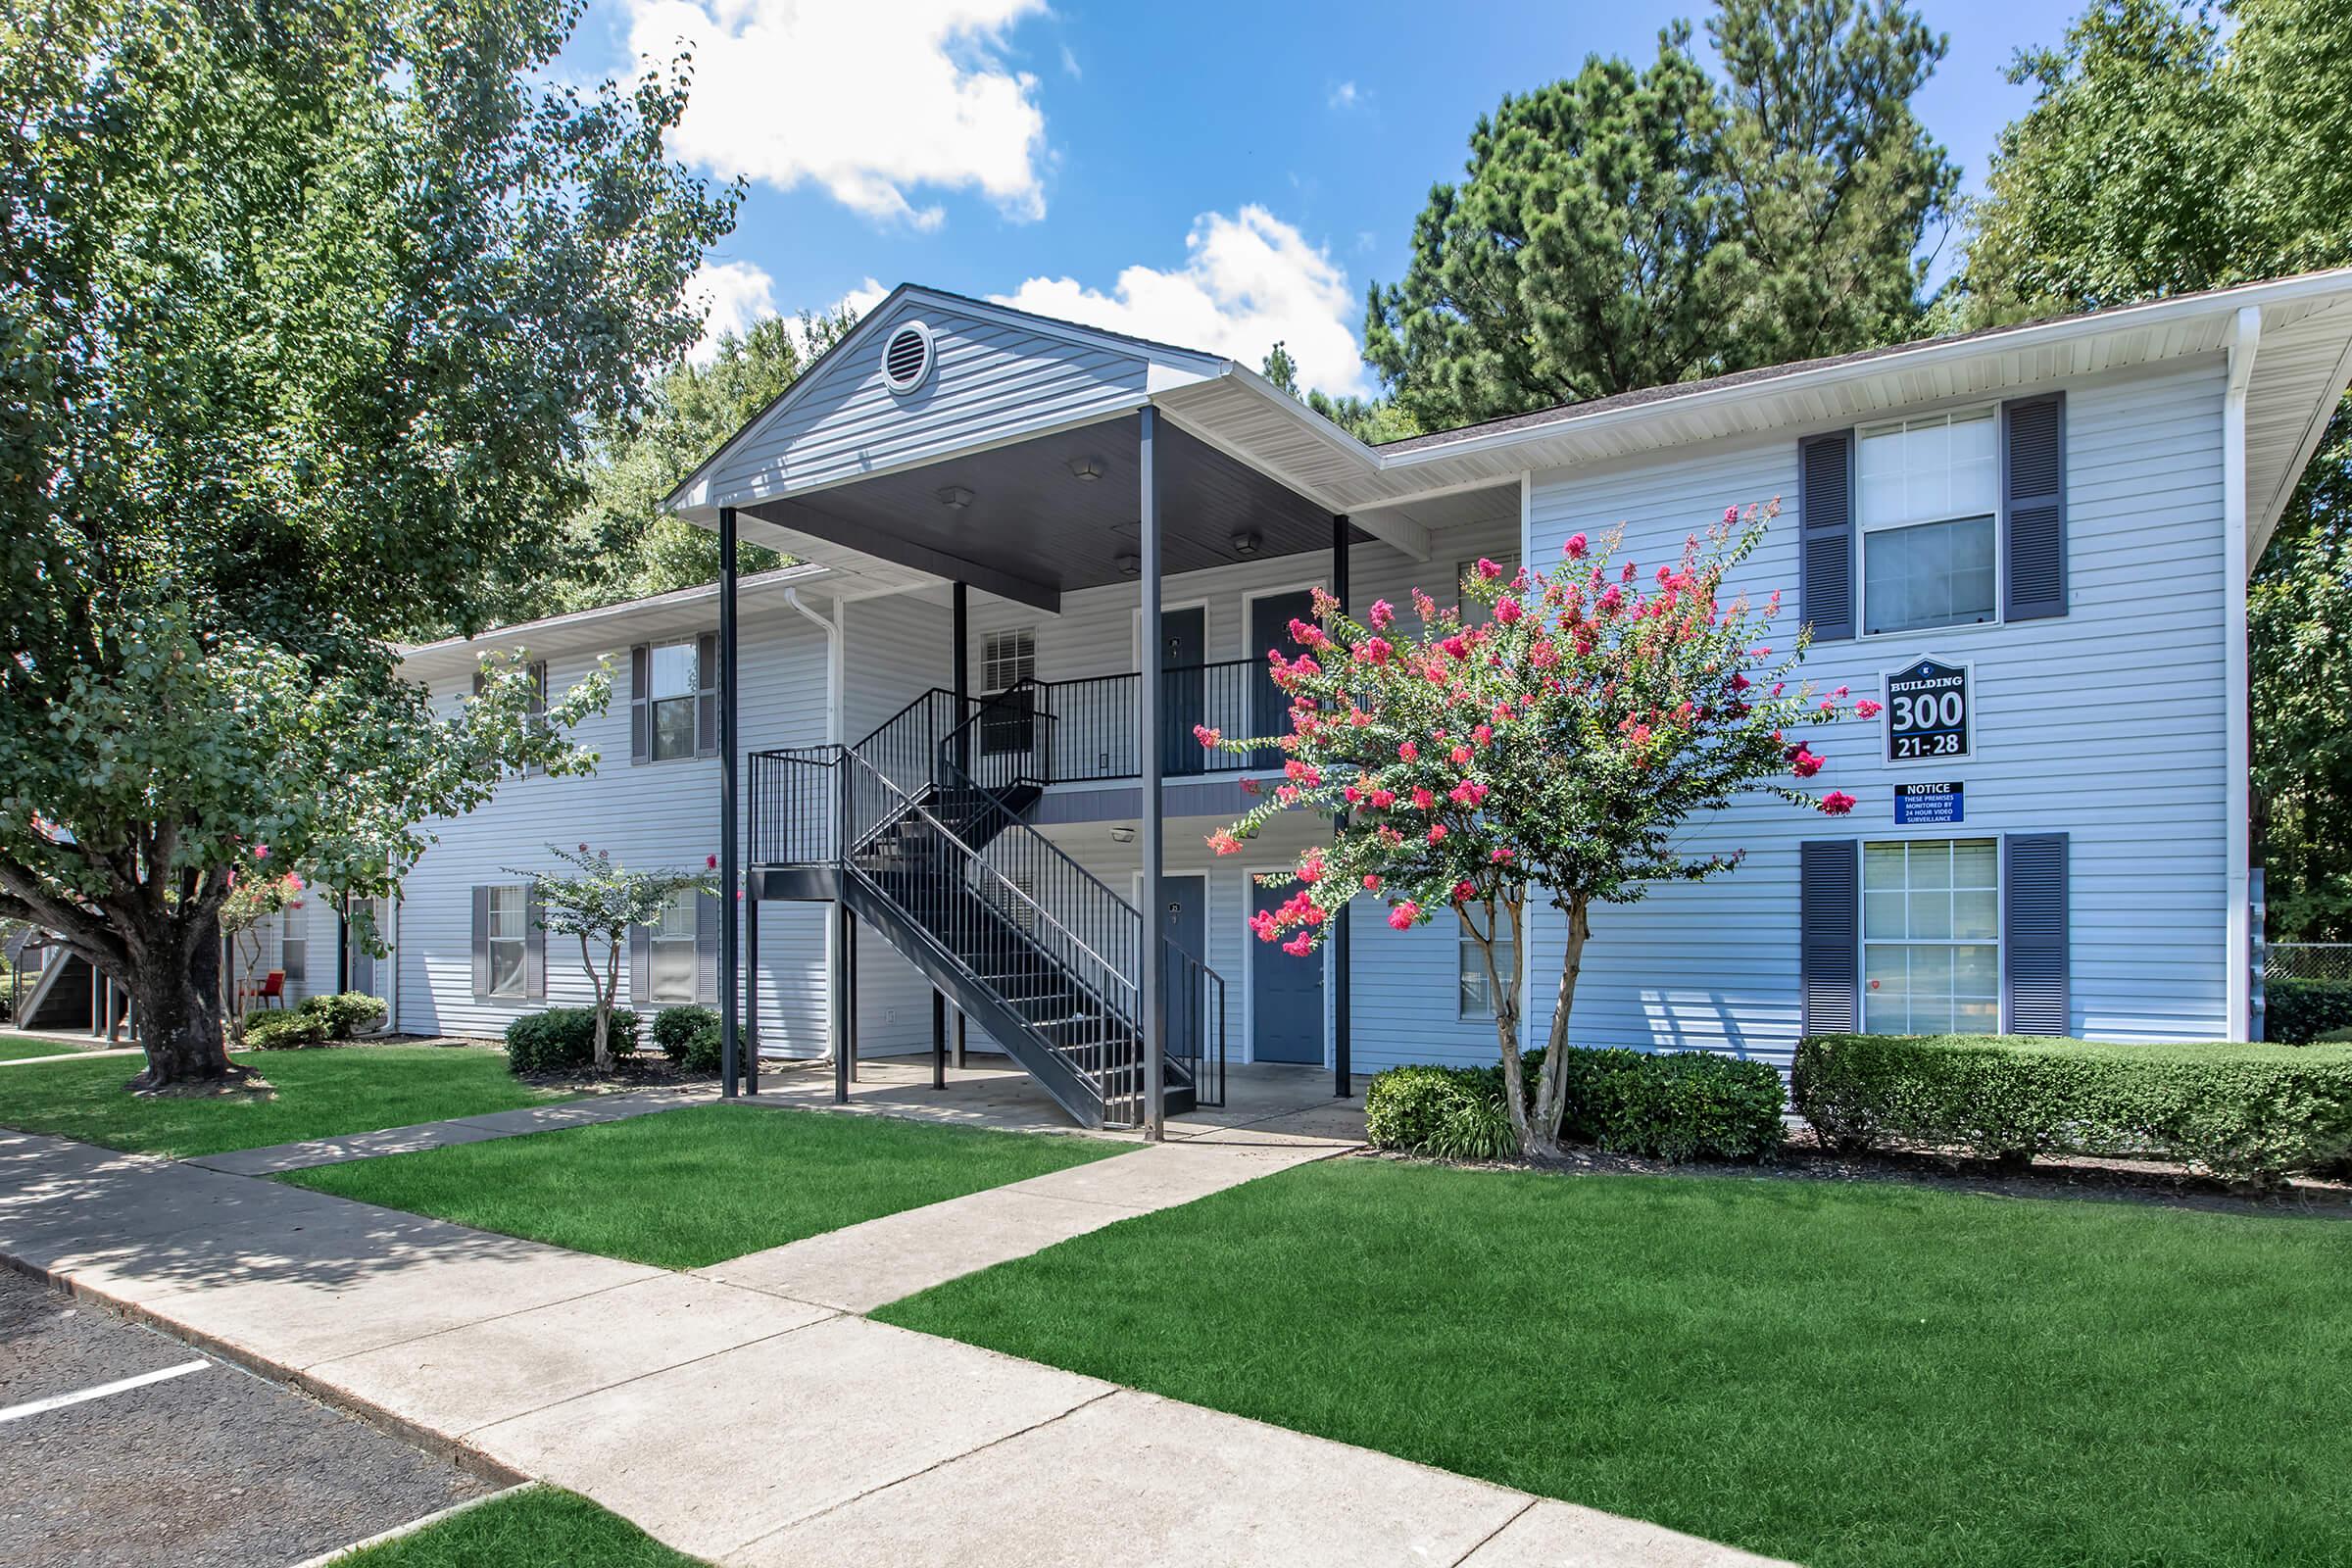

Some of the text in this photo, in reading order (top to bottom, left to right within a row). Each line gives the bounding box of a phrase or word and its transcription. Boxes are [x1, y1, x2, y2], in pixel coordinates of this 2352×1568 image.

[1890, 676, 1963, 691] BUILDING
[1892, 691, 1963, 731] 300
[1907, 784, 1950, 794] NOTICE
